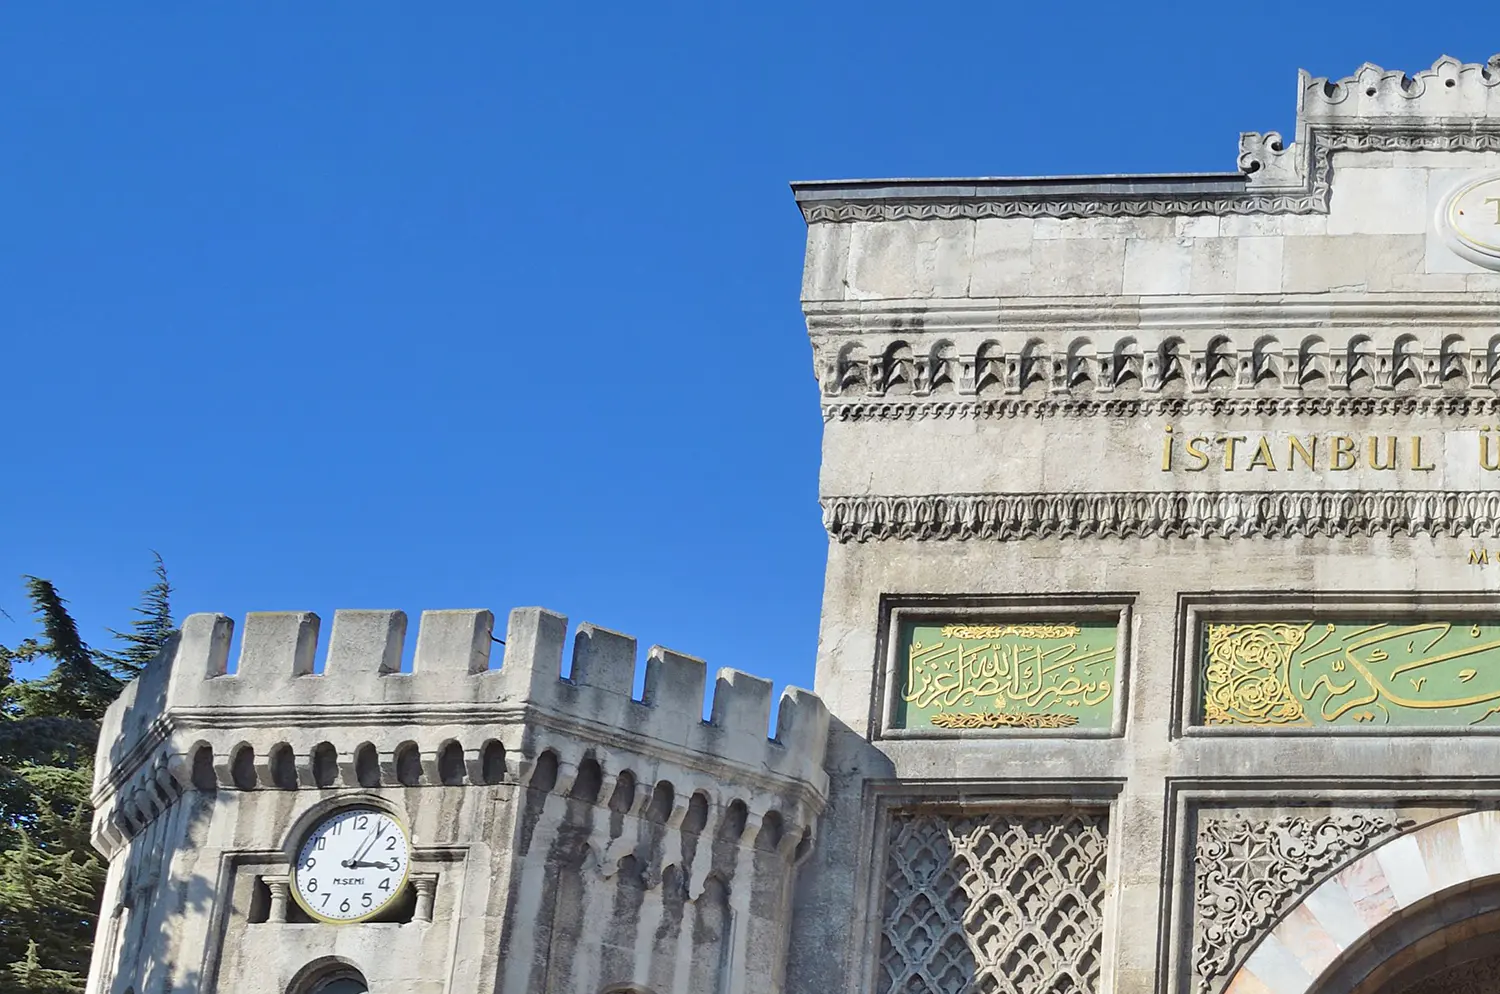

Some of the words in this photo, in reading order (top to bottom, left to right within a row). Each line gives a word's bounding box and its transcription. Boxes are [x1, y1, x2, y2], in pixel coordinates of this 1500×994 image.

[1161, 425, 1436, 472] İSTANBUL
[332, 822, 342, 836] 11
[353, 816, 368, 830] 12
[313, 836, 326, 851] 10
[385, 836, 397, 850] 2
[305, 857, 316, 872] 9
[390, 857, 401, 872] 3
[307, 878, 318, 893] 8
[378, 878, 391, 892] 4
[321, 893, 331, 908] 7
[340, 898, 351, 913] 6
[361, 893, 373, 908] 5
